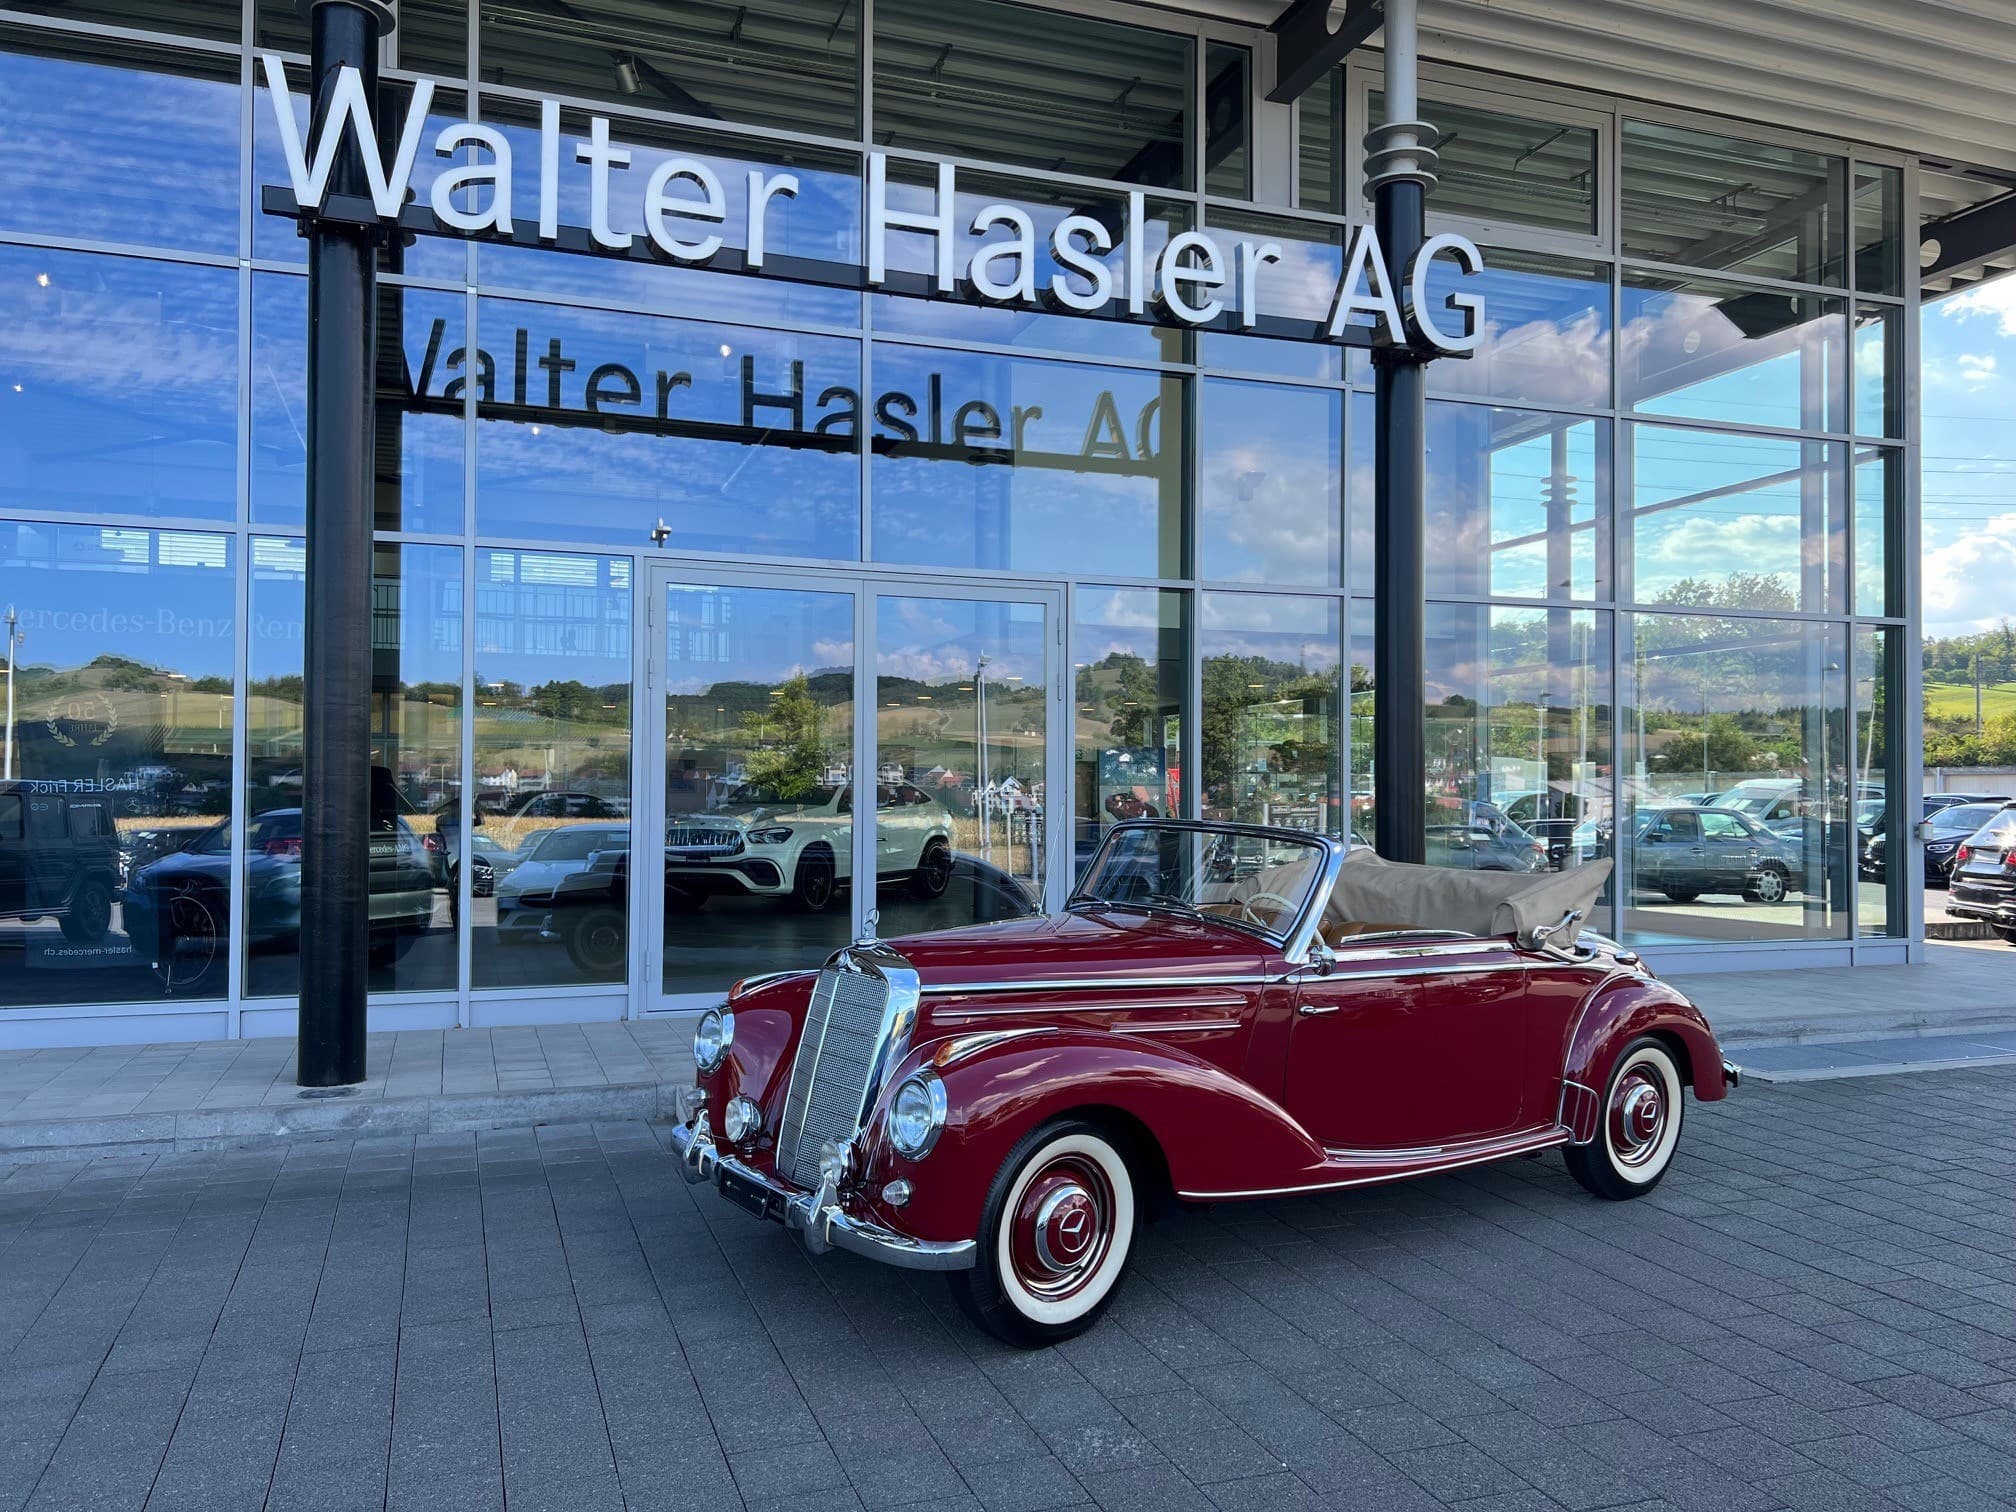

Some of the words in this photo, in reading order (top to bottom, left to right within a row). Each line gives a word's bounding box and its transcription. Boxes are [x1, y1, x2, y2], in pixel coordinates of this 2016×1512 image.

[261, 54, 799, 268] Walter
[866, 152, 1282, 327] Hasler
[1328, 224, 1486, 353] AG
[740, 354, 1043, 458] Hasler
[249, 612, 304, 640] Ren
